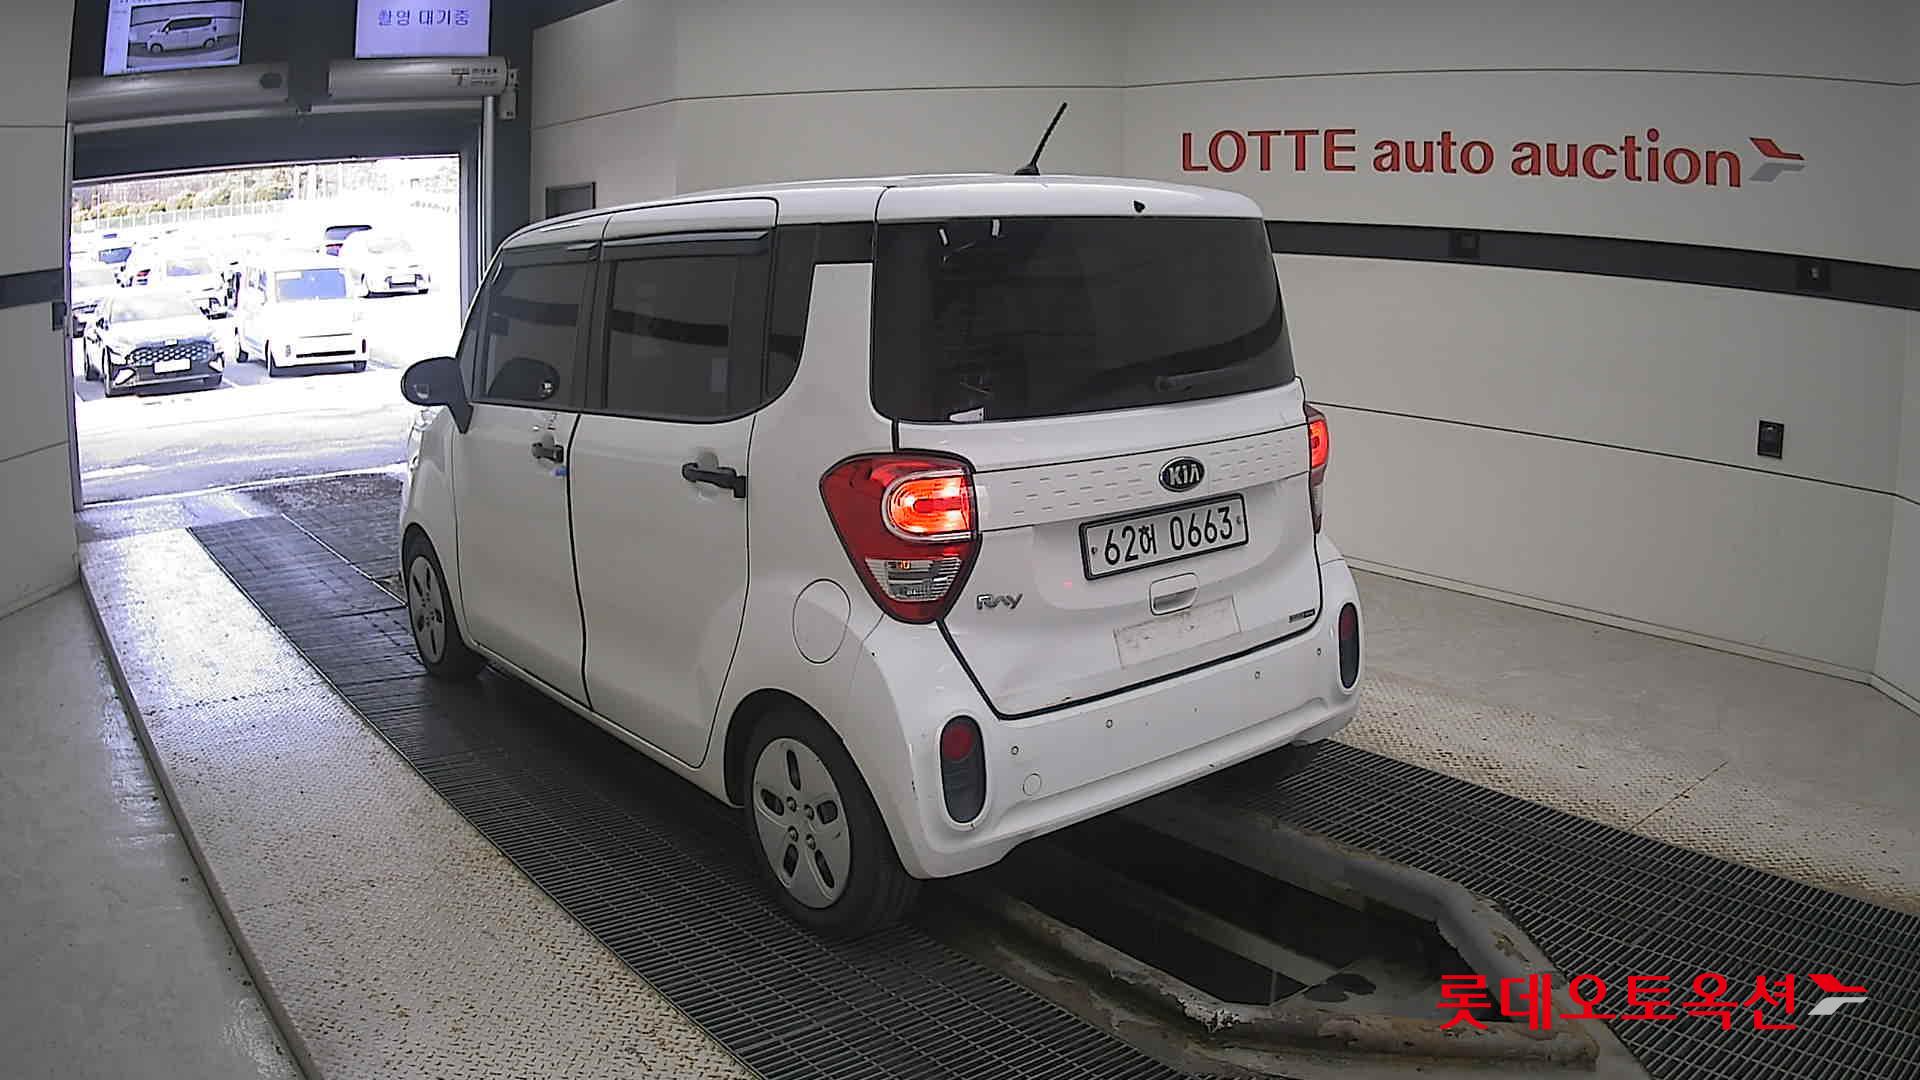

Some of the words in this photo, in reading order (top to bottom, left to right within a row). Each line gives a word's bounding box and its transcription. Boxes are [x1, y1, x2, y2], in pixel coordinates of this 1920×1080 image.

[419, 9, 469, 26] 대기중
[1181, 129, 1357, 172] LOTTE
[1373, 131, 1495, 174] auto
[1511, 128, 1743, 188] auction
[1168, 463, 1200, 486] KIA
[1104, 523, 1157, 565] 62허
[1169, 506, 1233, 551] 0663
